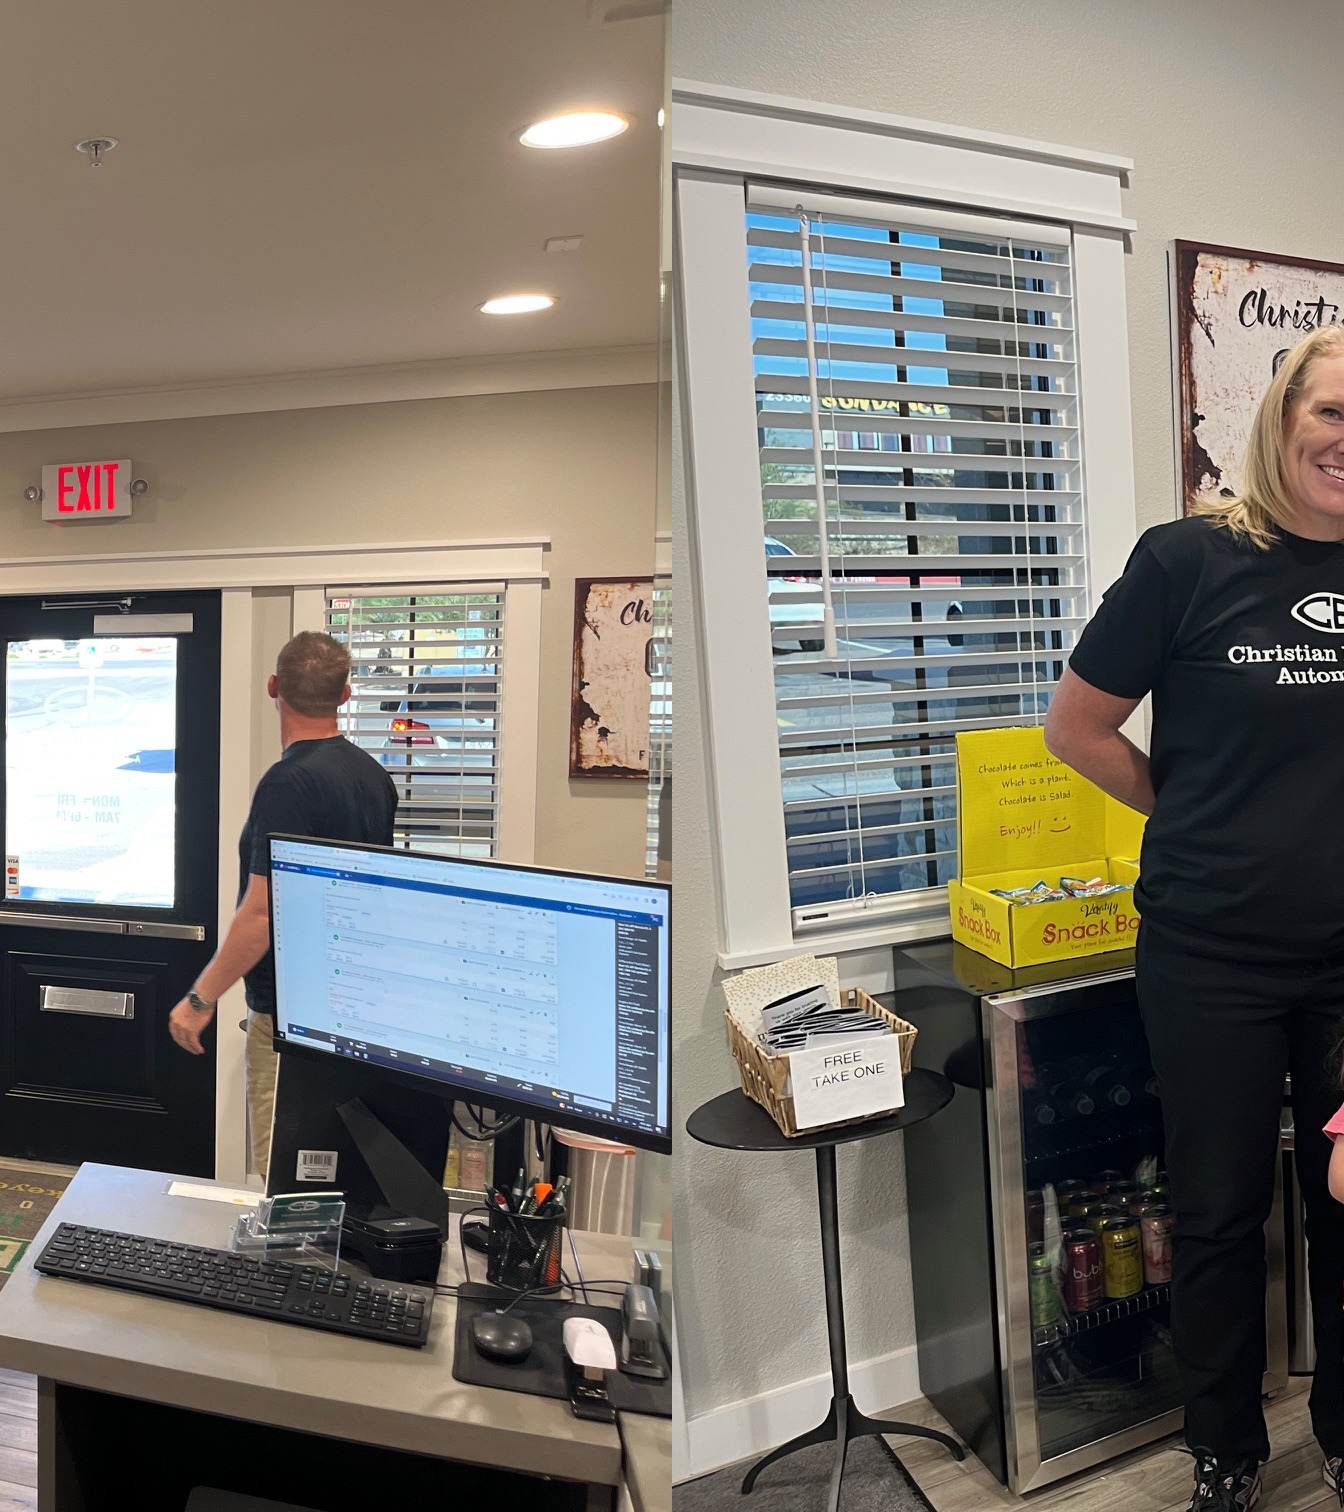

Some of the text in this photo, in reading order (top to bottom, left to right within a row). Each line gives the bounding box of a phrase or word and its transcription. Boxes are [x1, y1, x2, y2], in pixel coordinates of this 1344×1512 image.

[57, 463, 119, 512] EXIT
[620, 599, 653, 625] Ch
[1227, 644, 1338, 664] Christian
[978, 762, 1016, 774] Chocolate
[1020, 760, 1043, 769] comes
[1002, 777, 1026, 788] Which
[999, 794, 1037, 806] Chocolate
[1039, 794, 1046, 802] is
[1000, 820, 1041, 839] Enjoy!!
[958, 906, 984, 937] Snack
[985, 919, 1002, 945] Box
[1042, 914, 1141, 946] Snack Bo
[824, 1050, 862, 1068] FREE
[812, 1062, 885, 1088] TAKE ONE
